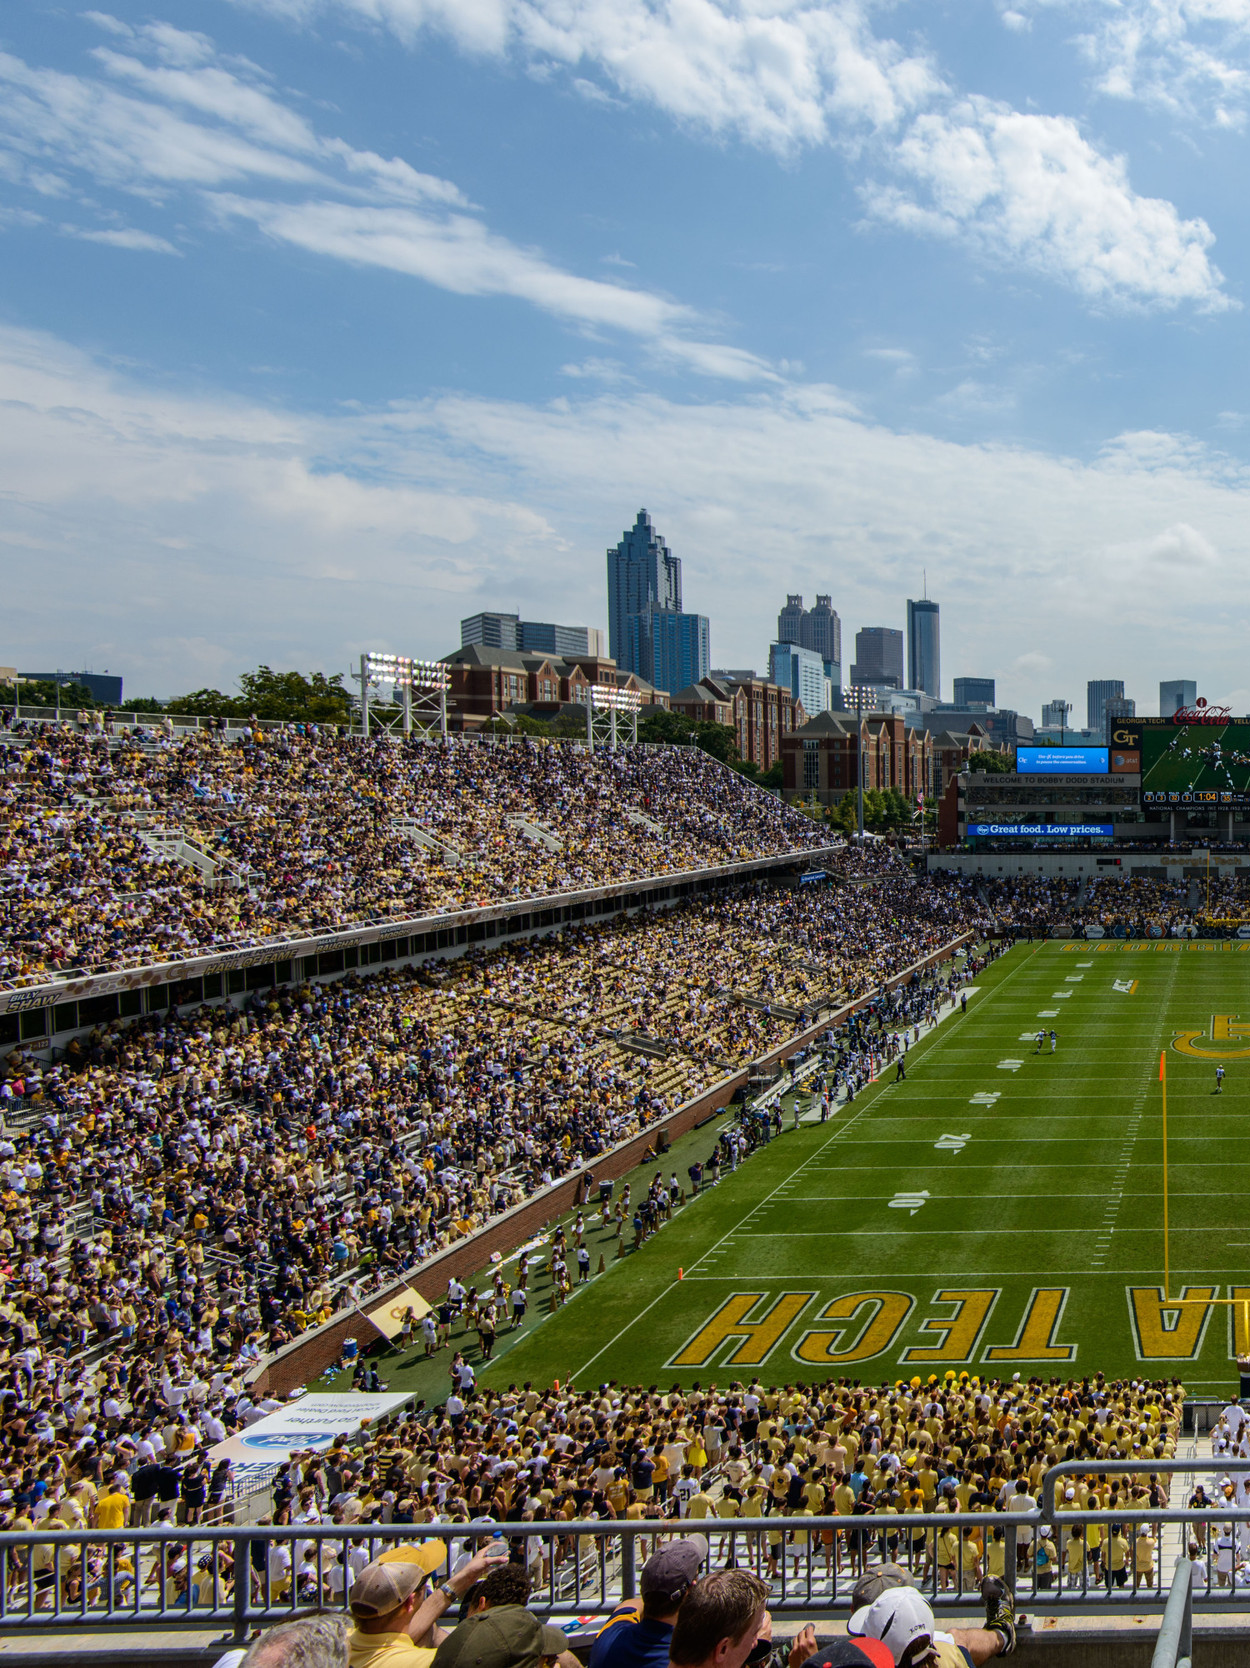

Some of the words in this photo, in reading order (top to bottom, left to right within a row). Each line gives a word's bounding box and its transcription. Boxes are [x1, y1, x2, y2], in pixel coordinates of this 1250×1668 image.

[1113, 729, 1139, 746] GT
[1199, 793, 1216, 801] 1:04
[990, 825, 1019, 834] Great
[1020, 825, 1044, 834] food.
[1047, 825, 1068, 834] Low
[1069, 825, 1104, 835] prices.
[1160, 856, 1209, 866] Georgia
[1213, 856, 1242, 865] Tech
[314, 937, 362, 953] BAUGHAN
[317, 936, 339, 946] MAXIE
[203, 961, 240, 976] HALL
[241, 956, 261, 969] OF
[261, 949, 298, 966] FAME
[1112, 978, 1135, 994] ACC
[6, 992, 62, 1013] SHAW
[9, 990, 42, 1003] BILLY
[968, 1091, 1002, 1104] 30
[934, 1133, 972, 1149] 20
[887, 1190, 931, 1208] 10
[661, 1285, 1079, 1369] TECH
[284, 1416, 335, 1425] Further
[336, 1416, 359, 1424] Go
[256, 1434, 322, 1448] Ford
[679, 1488, 690, 1502] 21
